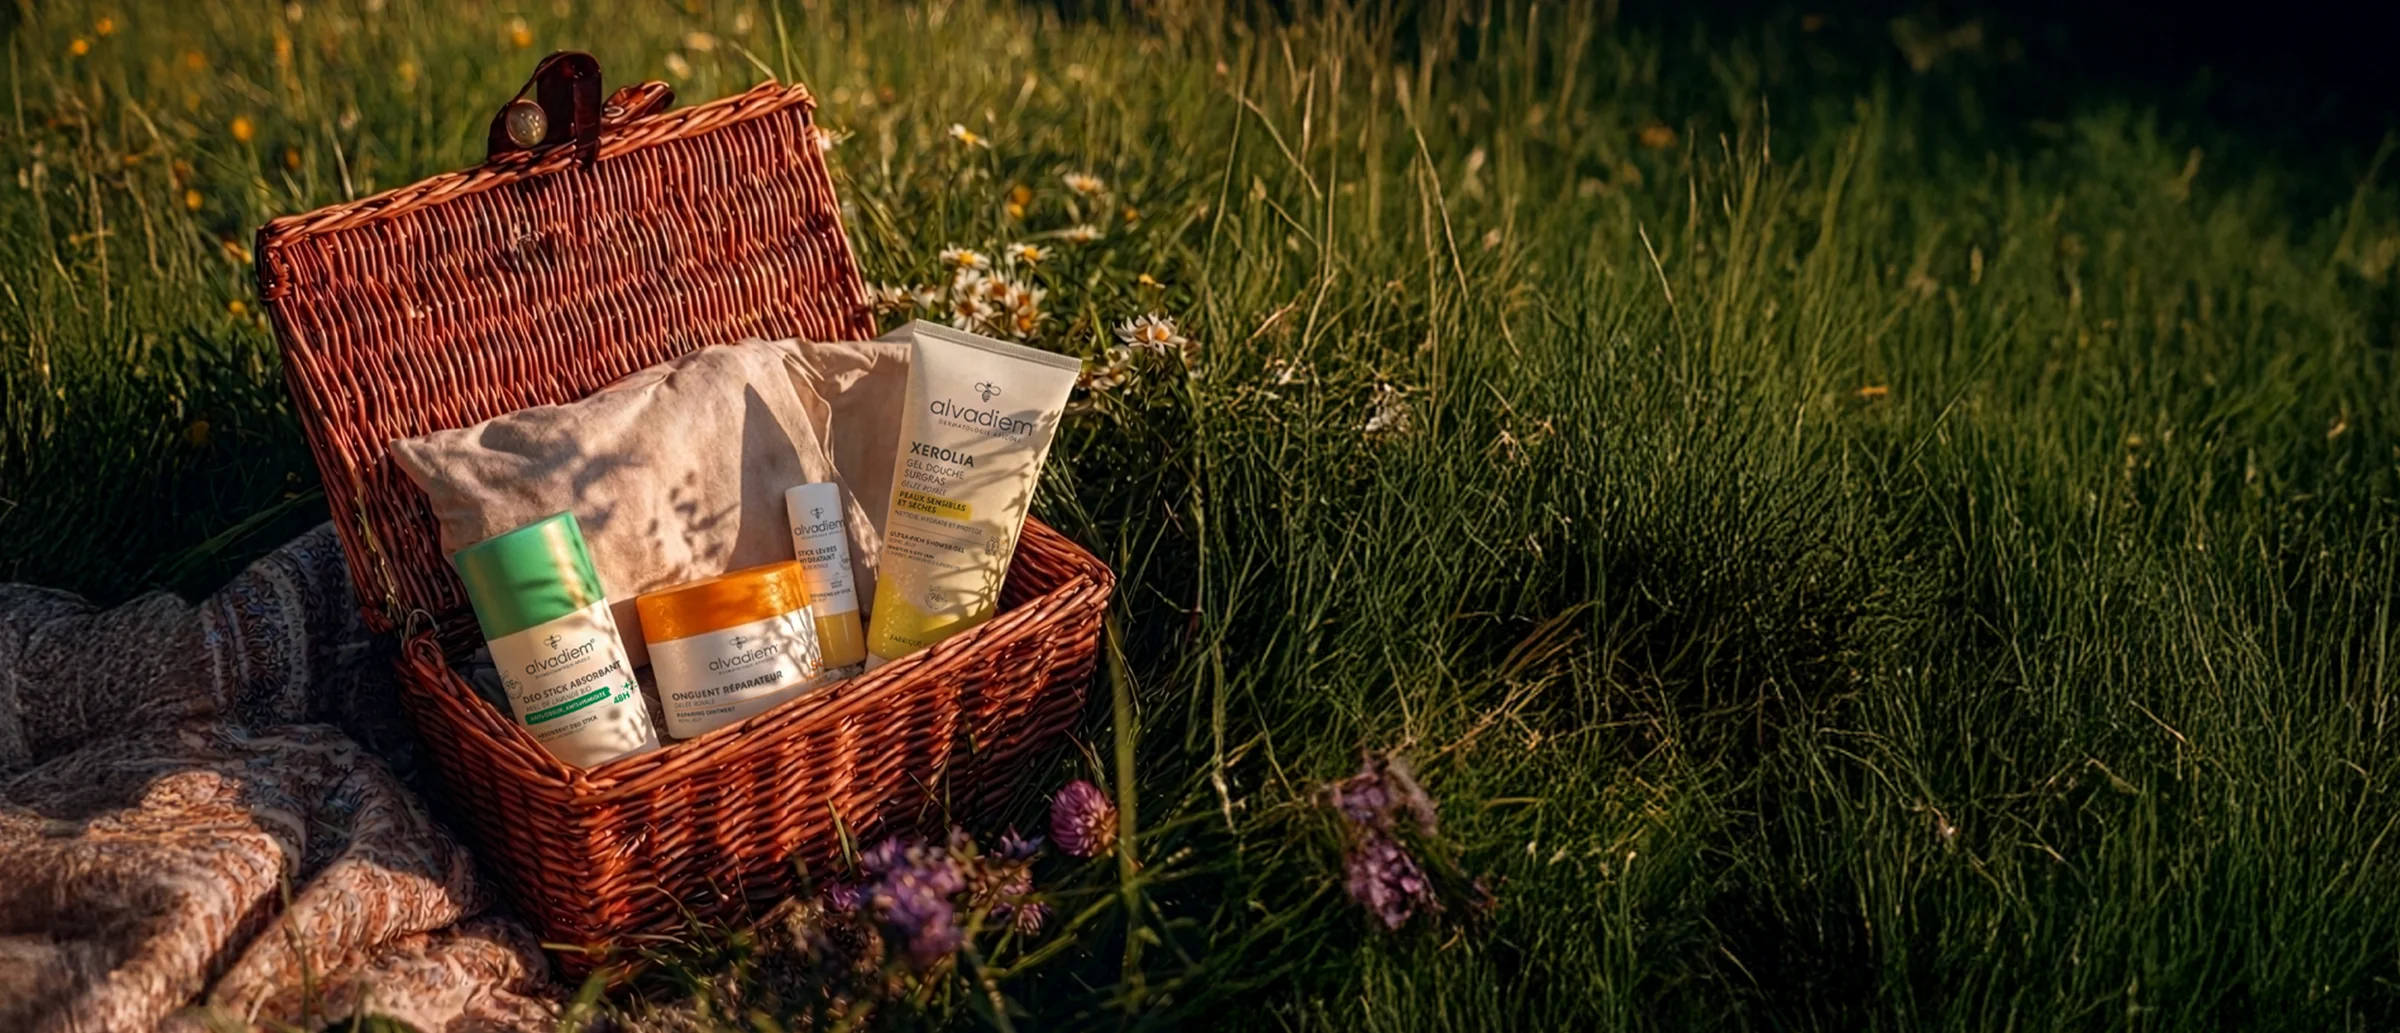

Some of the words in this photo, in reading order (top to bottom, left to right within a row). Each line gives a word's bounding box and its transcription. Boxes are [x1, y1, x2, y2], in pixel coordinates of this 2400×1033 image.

[930, 399, 1033, 436] alvadiem
[910, 441, 974, 468] XEROLIA
[904, 469, 946, 486] SURGRAS
[906, 458, 923, 471] GEL
[926, 462, 965, 480] DOUCHE
[897, 499, 907, 507] ET
[899, 490, 925, 503] PEAUX
[927, 497, 966, 512] SENSIBLES
[794, 518, 845, 536] alvadiem
[526, 642, 594, 675] alvadiem
[709, 645, 778, 671] alvadiem
[543, 684, 569, 698] STICK
[570, 660, 621, 689] ABSORBANT
[671, 687, 720, 701] ONGUENT
[722, 670, 783, 694] RÉPARATEUR
[614, 691, 631, 704] 48H
